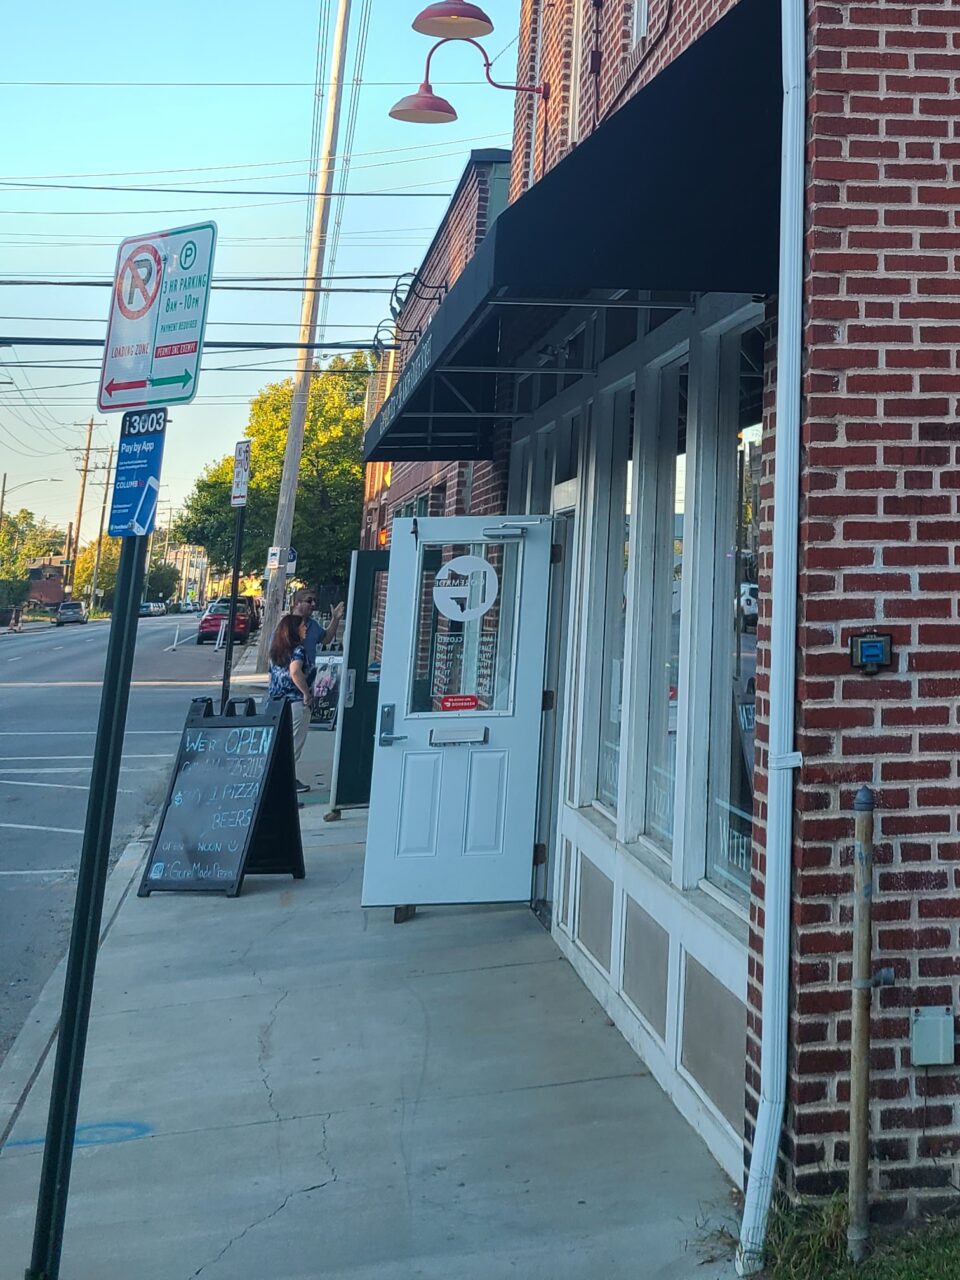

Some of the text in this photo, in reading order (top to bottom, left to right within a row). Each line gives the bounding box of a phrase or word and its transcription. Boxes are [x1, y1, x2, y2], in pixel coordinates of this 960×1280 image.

[163, 274, 207, 294] 3 HR PARKING
[160, 319, 198, 333] PAYMENT REQUIRED
[111, 343, 149, 359] LOADING ZONE
[157, 346, 171, 357] PERMIT
[121, 441, 155, 454] Pay by App
[225, 728, 273, 754] OPEN
[212, 808, 253, 830] BEERS
[719, 816, 747, 871] WITH
